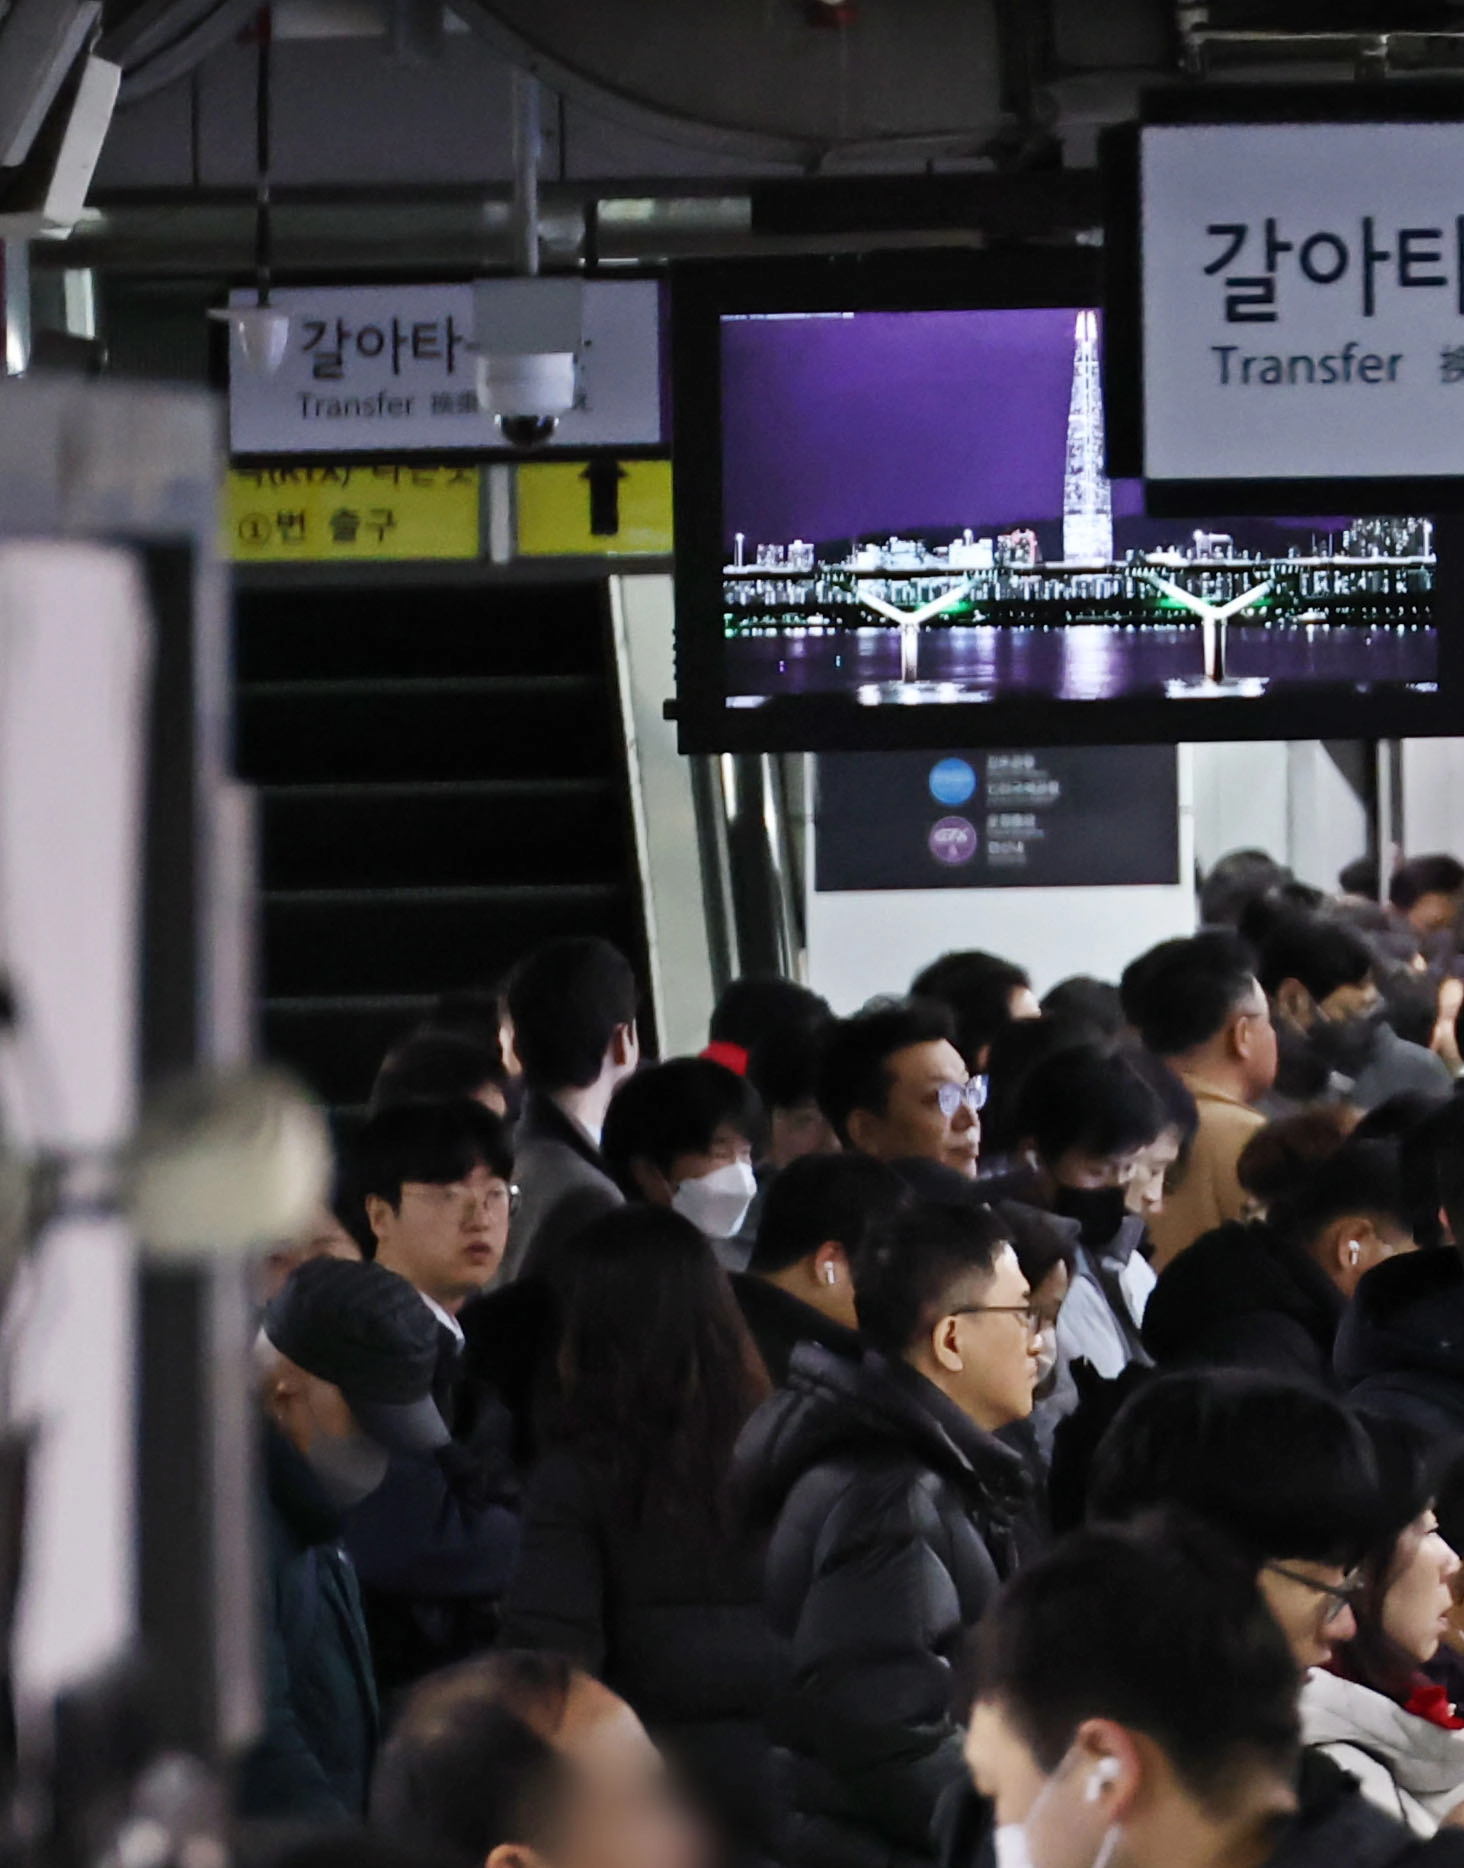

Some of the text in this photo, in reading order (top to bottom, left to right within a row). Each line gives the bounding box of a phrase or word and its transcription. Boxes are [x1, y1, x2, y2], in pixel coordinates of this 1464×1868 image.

[302, 314, 478, 380] 갈아타
[1211, 342, 1402, 385] Transfer
[300, 391, 415, 419] Transfer
